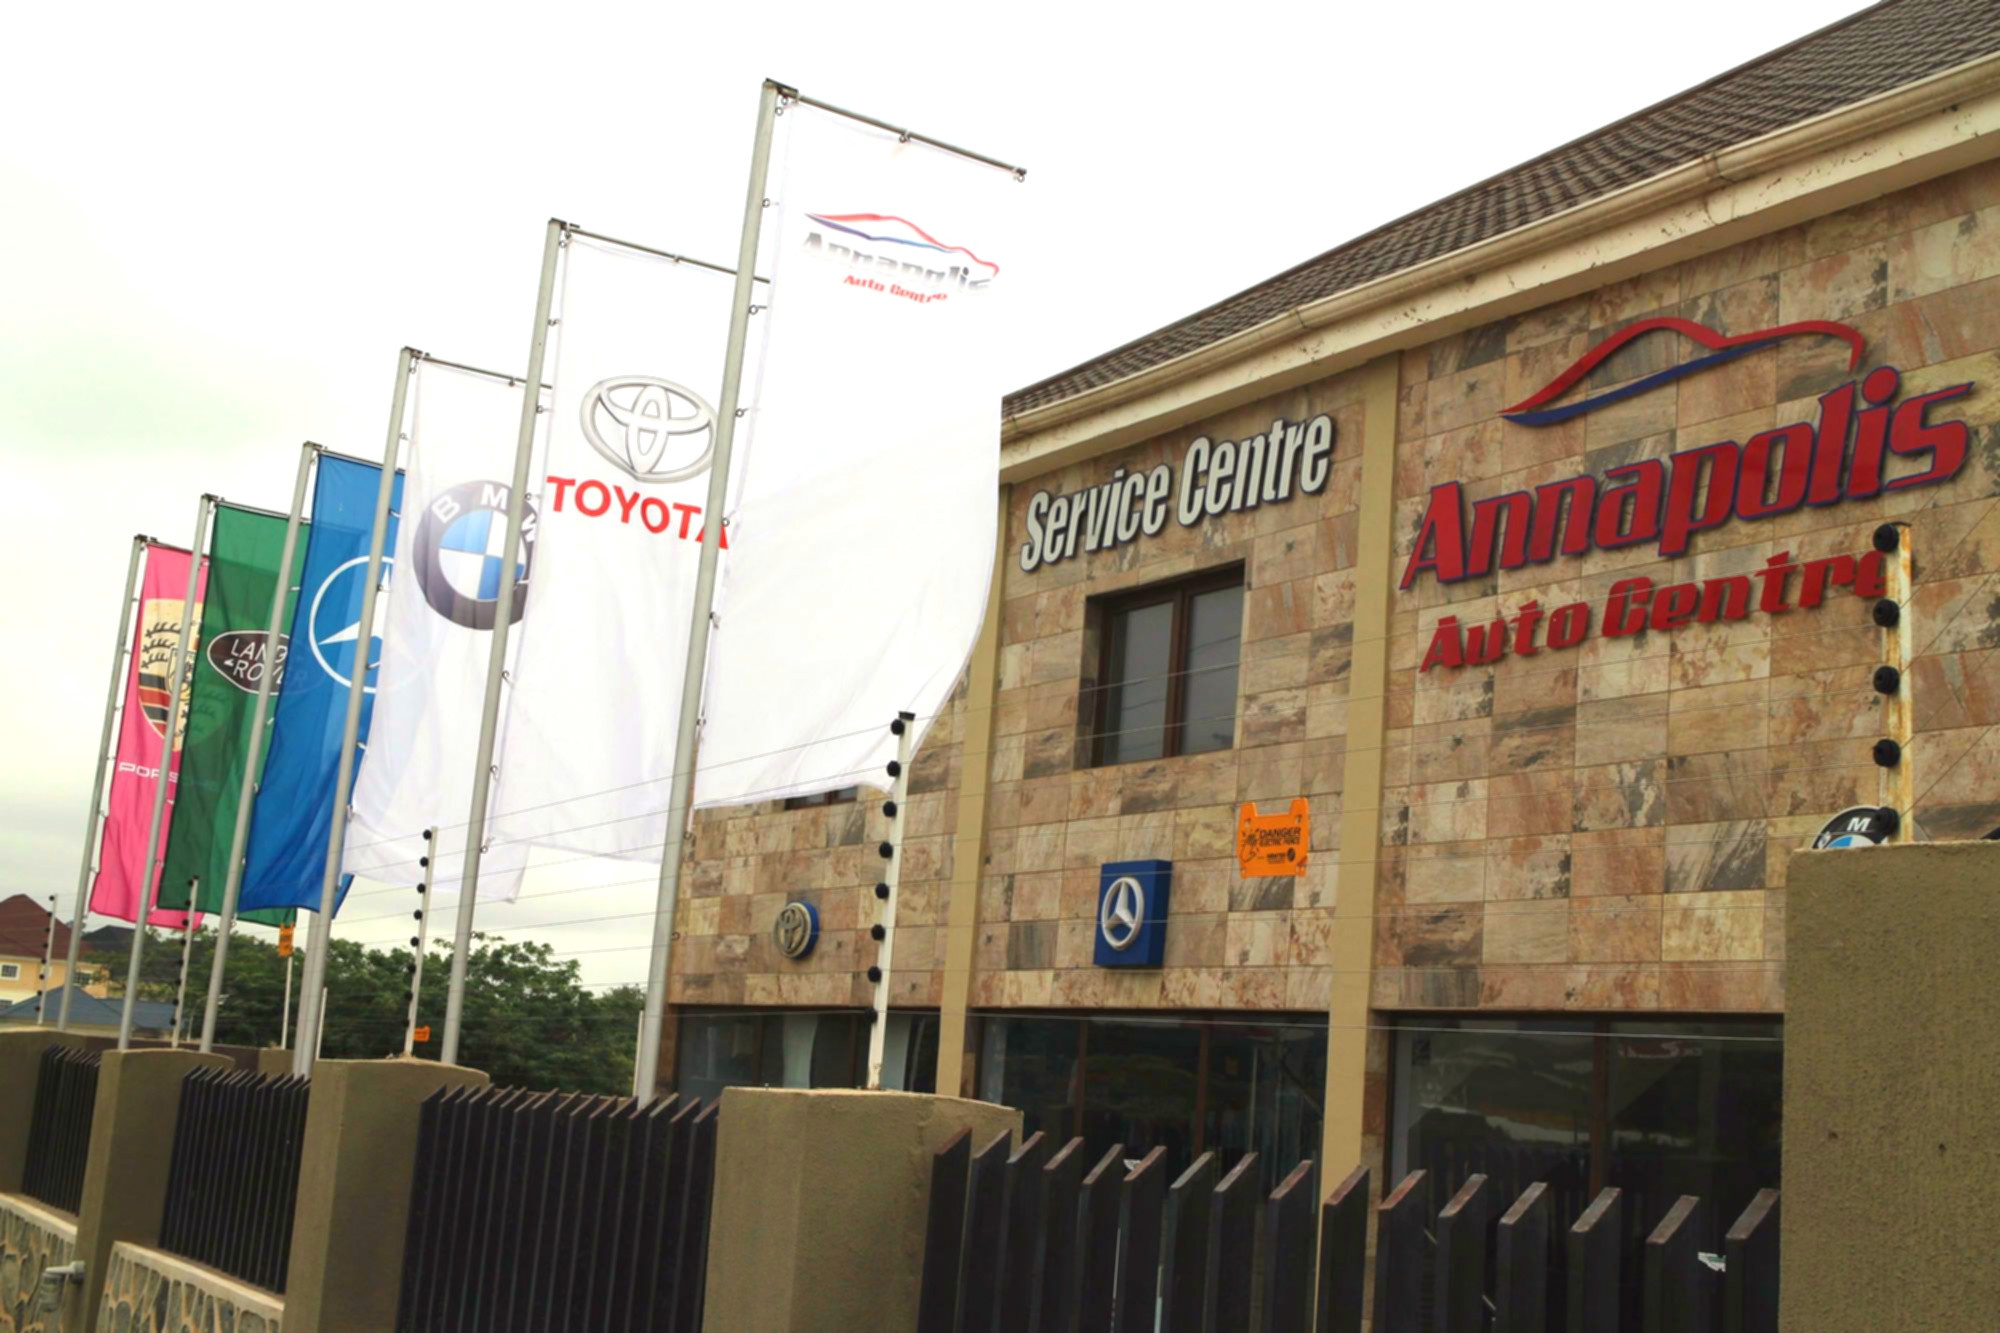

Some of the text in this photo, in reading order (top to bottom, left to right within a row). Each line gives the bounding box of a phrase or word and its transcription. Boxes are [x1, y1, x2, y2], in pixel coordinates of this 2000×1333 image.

[843, 274, 886, 293] Auto
[1019, 412, 1334, 573] Service Centre
[1400, 365, 1975, 591] Annapolis
[1419, 550, 1888, 673] Auto Centre
[119, 761, 179, 783] PORS
[1259, 826, 1302, 840] DANGER
[1817, 816, 1888, 849] BM
